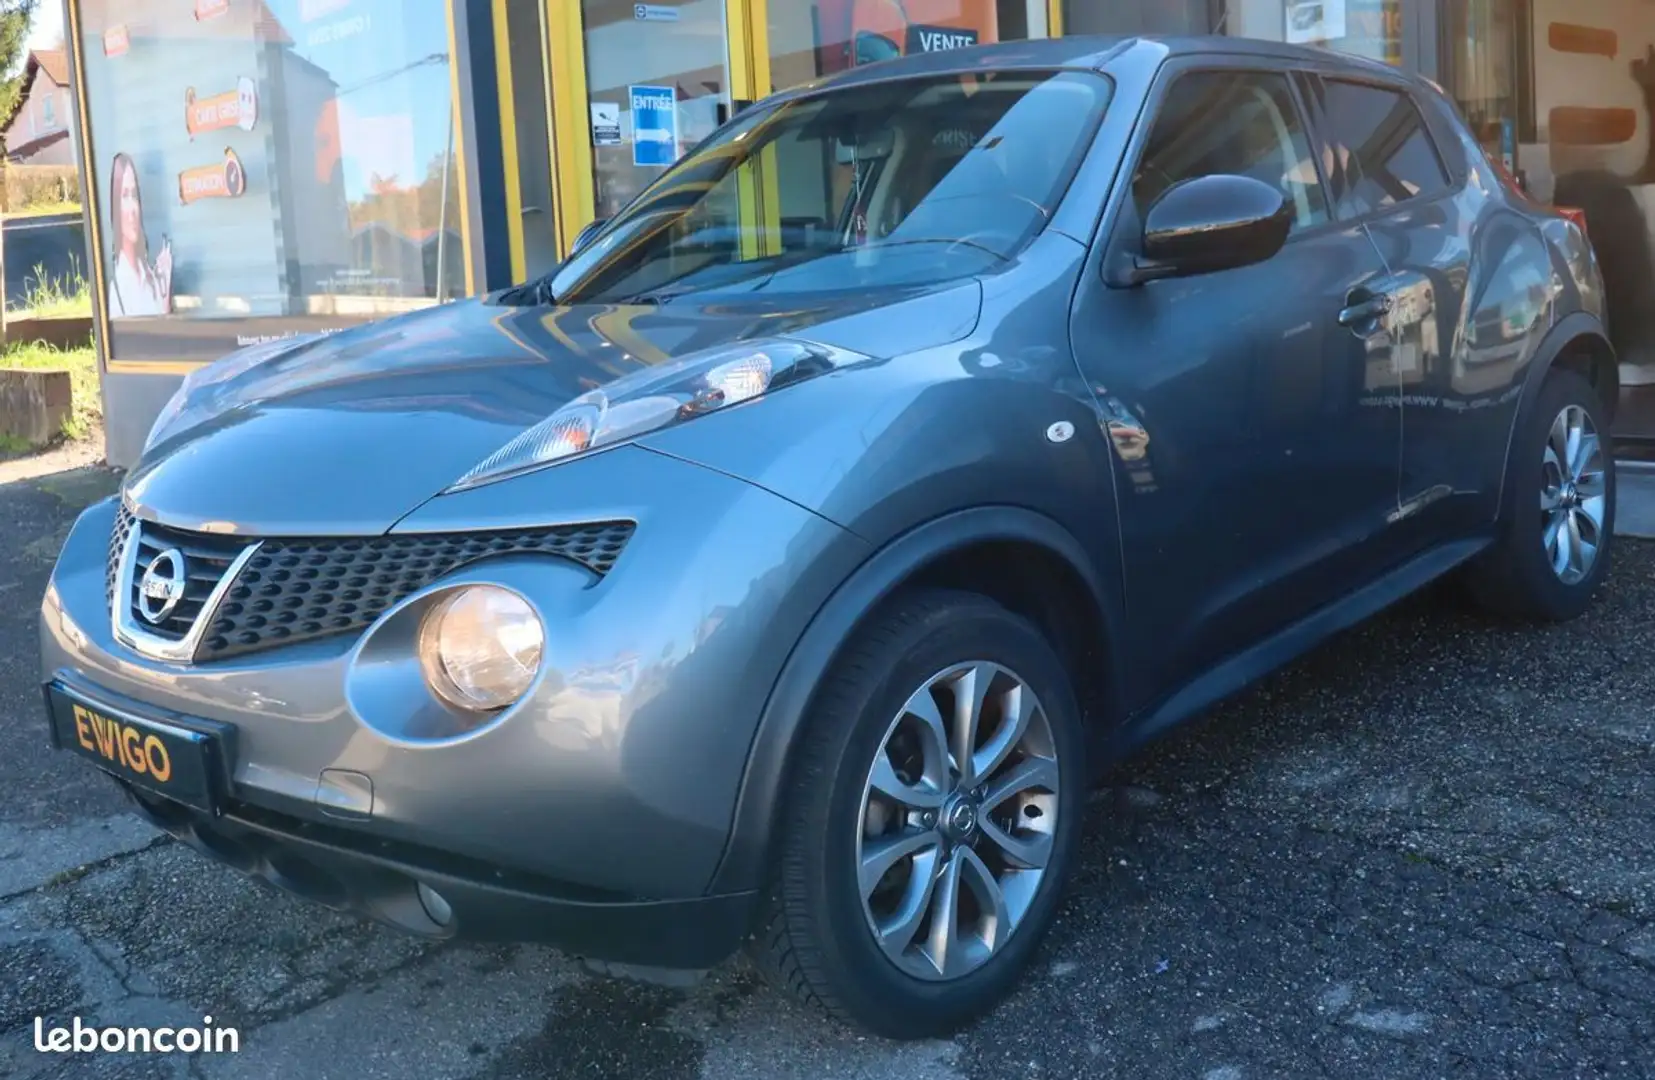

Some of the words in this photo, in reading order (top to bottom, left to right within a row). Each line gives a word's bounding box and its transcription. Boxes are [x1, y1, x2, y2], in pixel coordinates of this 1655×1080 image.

[919, 30, 975, 52] VENTE
[632, 93, 673, 110] ENTRÉE
[143, 580, 174, 596] SSAN
[74, 705, 171, 781] EWIGO
